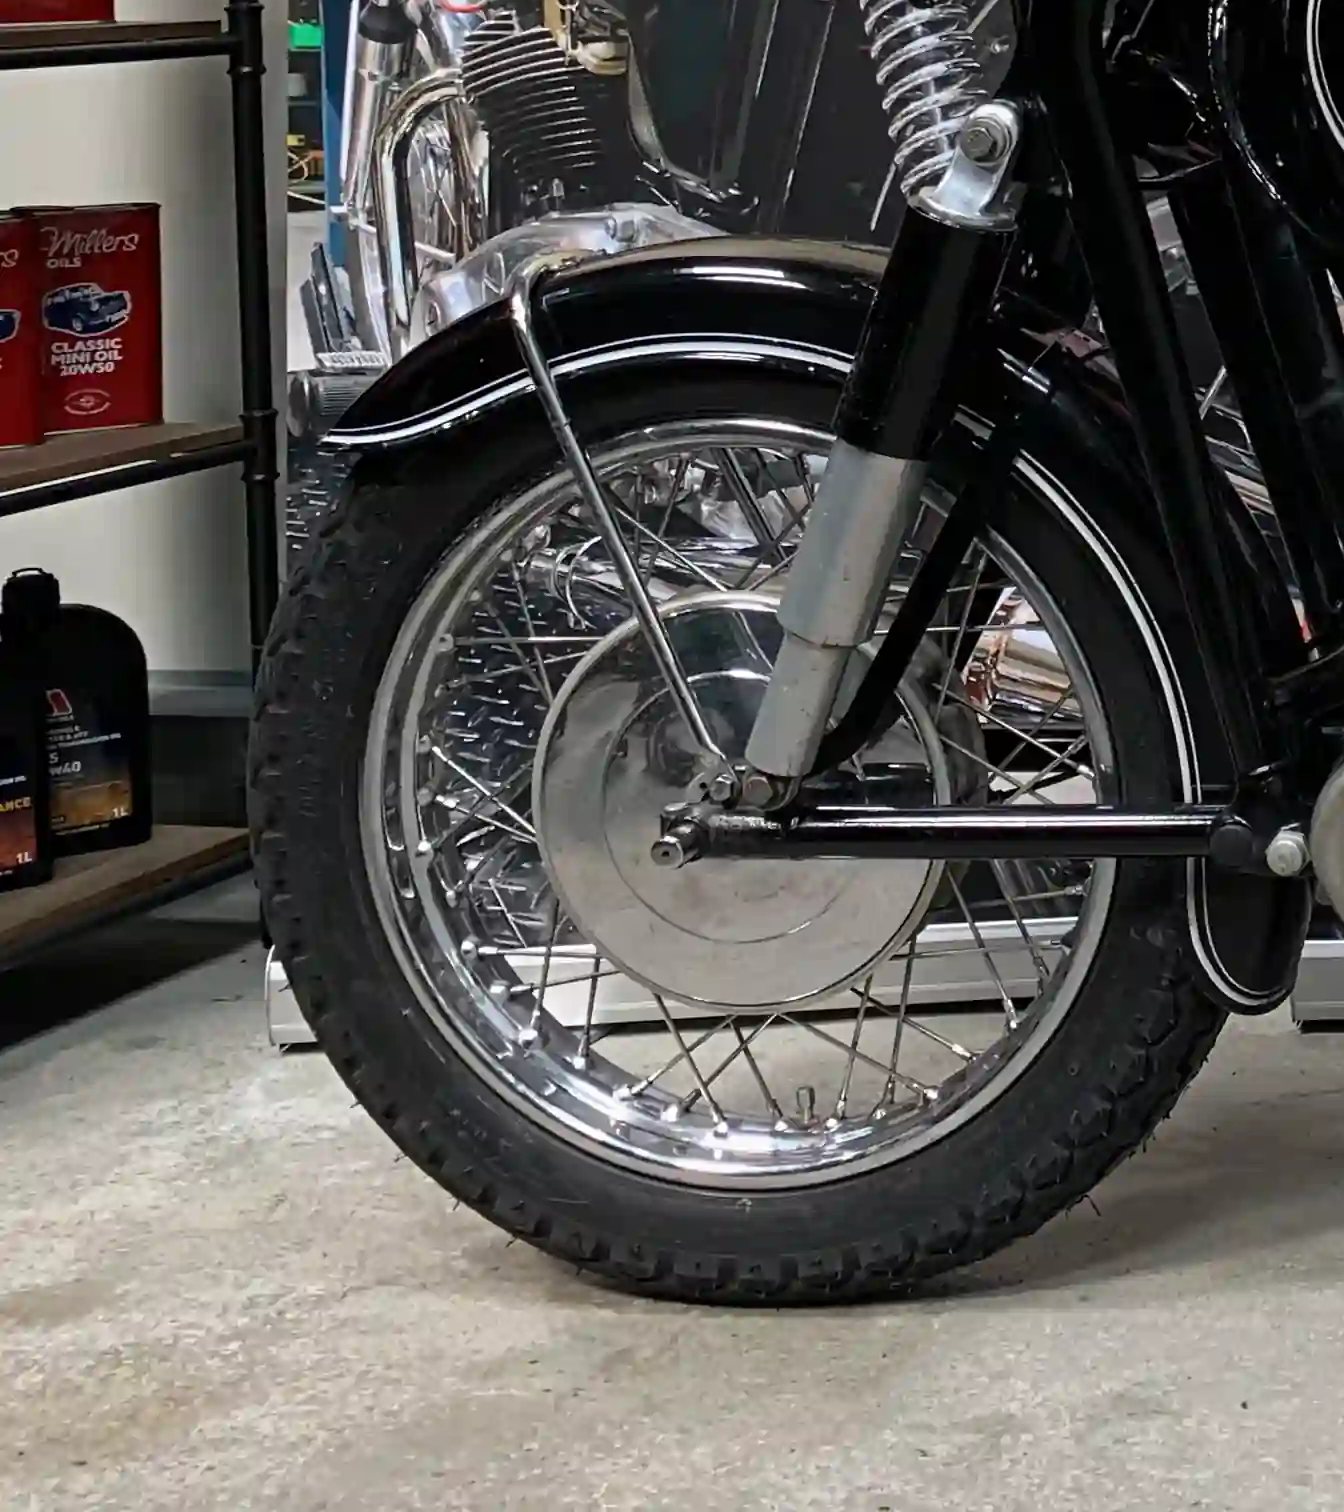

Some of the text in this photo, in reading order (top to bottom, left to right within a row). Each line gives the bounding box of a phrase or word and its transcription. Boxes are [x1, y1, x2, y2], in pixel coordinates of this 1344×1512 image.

[40, 226, 139, 257] Millers
[46, 256, 82, 268] OILS
[51, 338, 123, 354] CLASSIC
[94, 348, 124, 362] OIL
